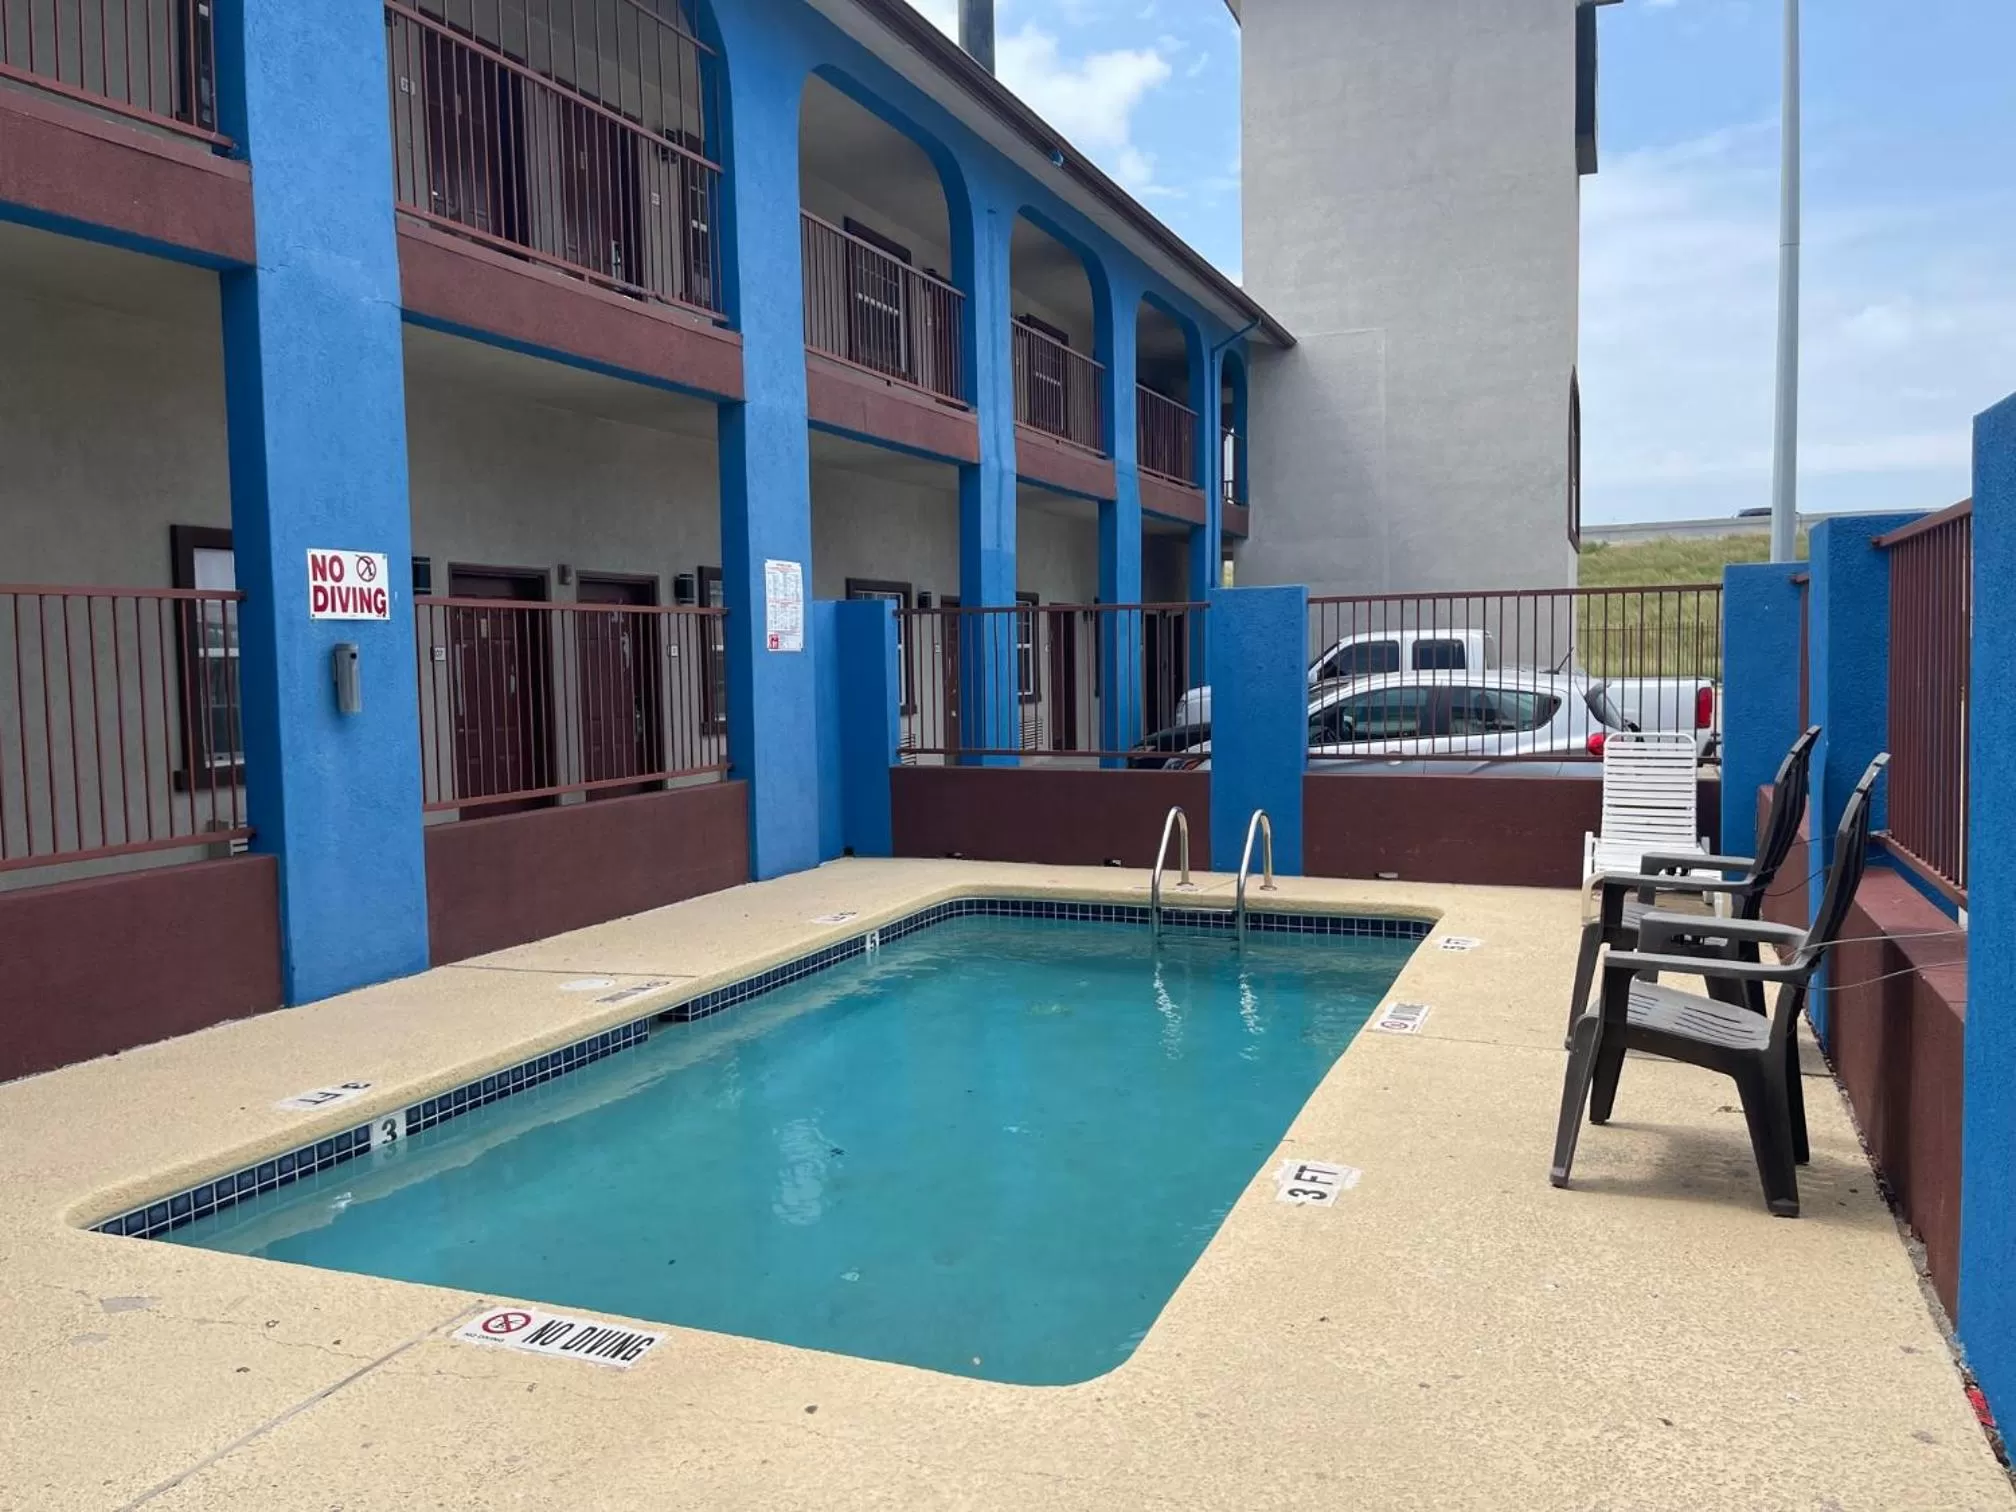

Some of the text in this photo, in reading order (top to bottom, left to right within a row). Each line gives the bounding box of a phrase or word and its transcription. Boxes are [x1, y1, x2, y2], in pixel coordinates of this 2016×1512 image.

[311, 553, 345, 582] NO
[313, 585, 387, 615] DIVING
[297, 1091, 344, 1105] FT
[381, 1118, 398, 1144] 3
[1288, 1165, 1340, 1200] 3 FT
[522, 1319, 655, 1361] NO DIVING
